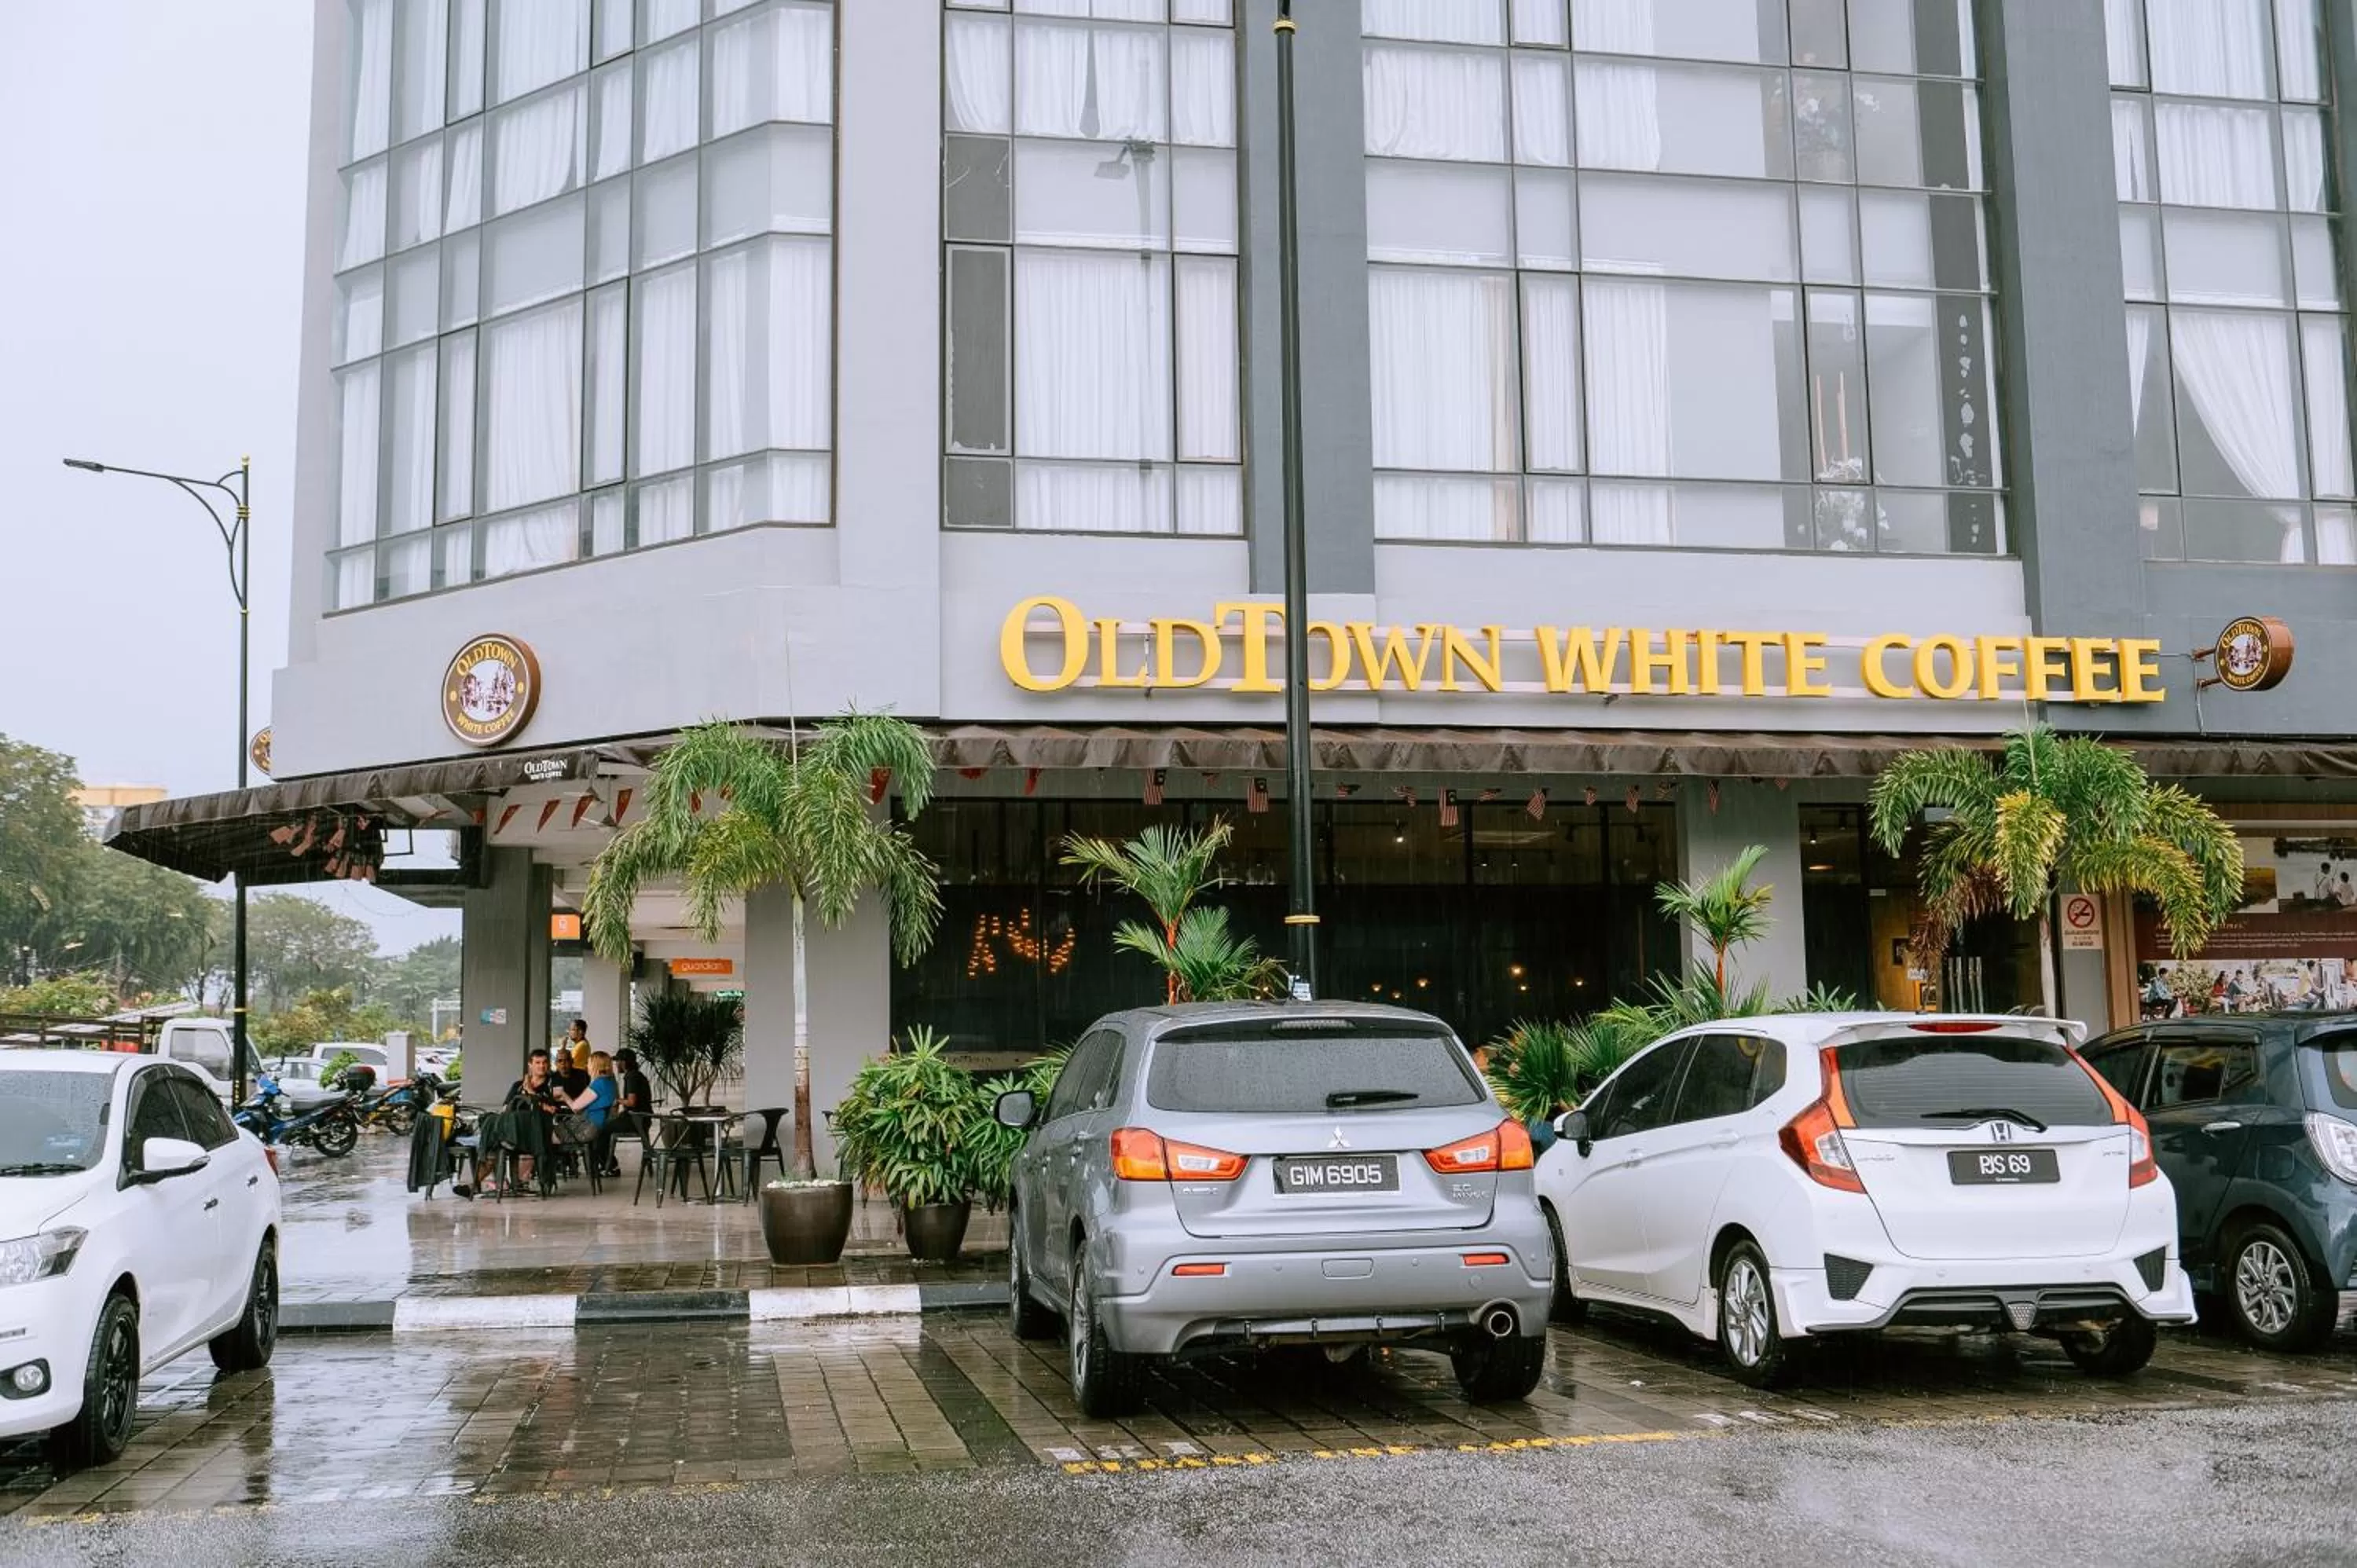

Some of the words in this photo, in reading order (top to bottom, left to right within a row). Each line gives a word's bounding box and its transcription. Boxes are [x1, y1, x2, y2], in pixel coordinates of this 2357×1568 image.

[456, 642, 519, 676] OLDTOWN
[1534, 627, 1833, 698] WHITE
[1860, 633, 2166, 704] COFFEE
[457, 713, 483, 735] WHITE
[485, 709, 516, 732] COFFEE
[1326, 1164, 1383, 1185] 6905
[1979, 1155, 2006, 1174] PJS
[2007, 1154, 2031, 1174] 69
